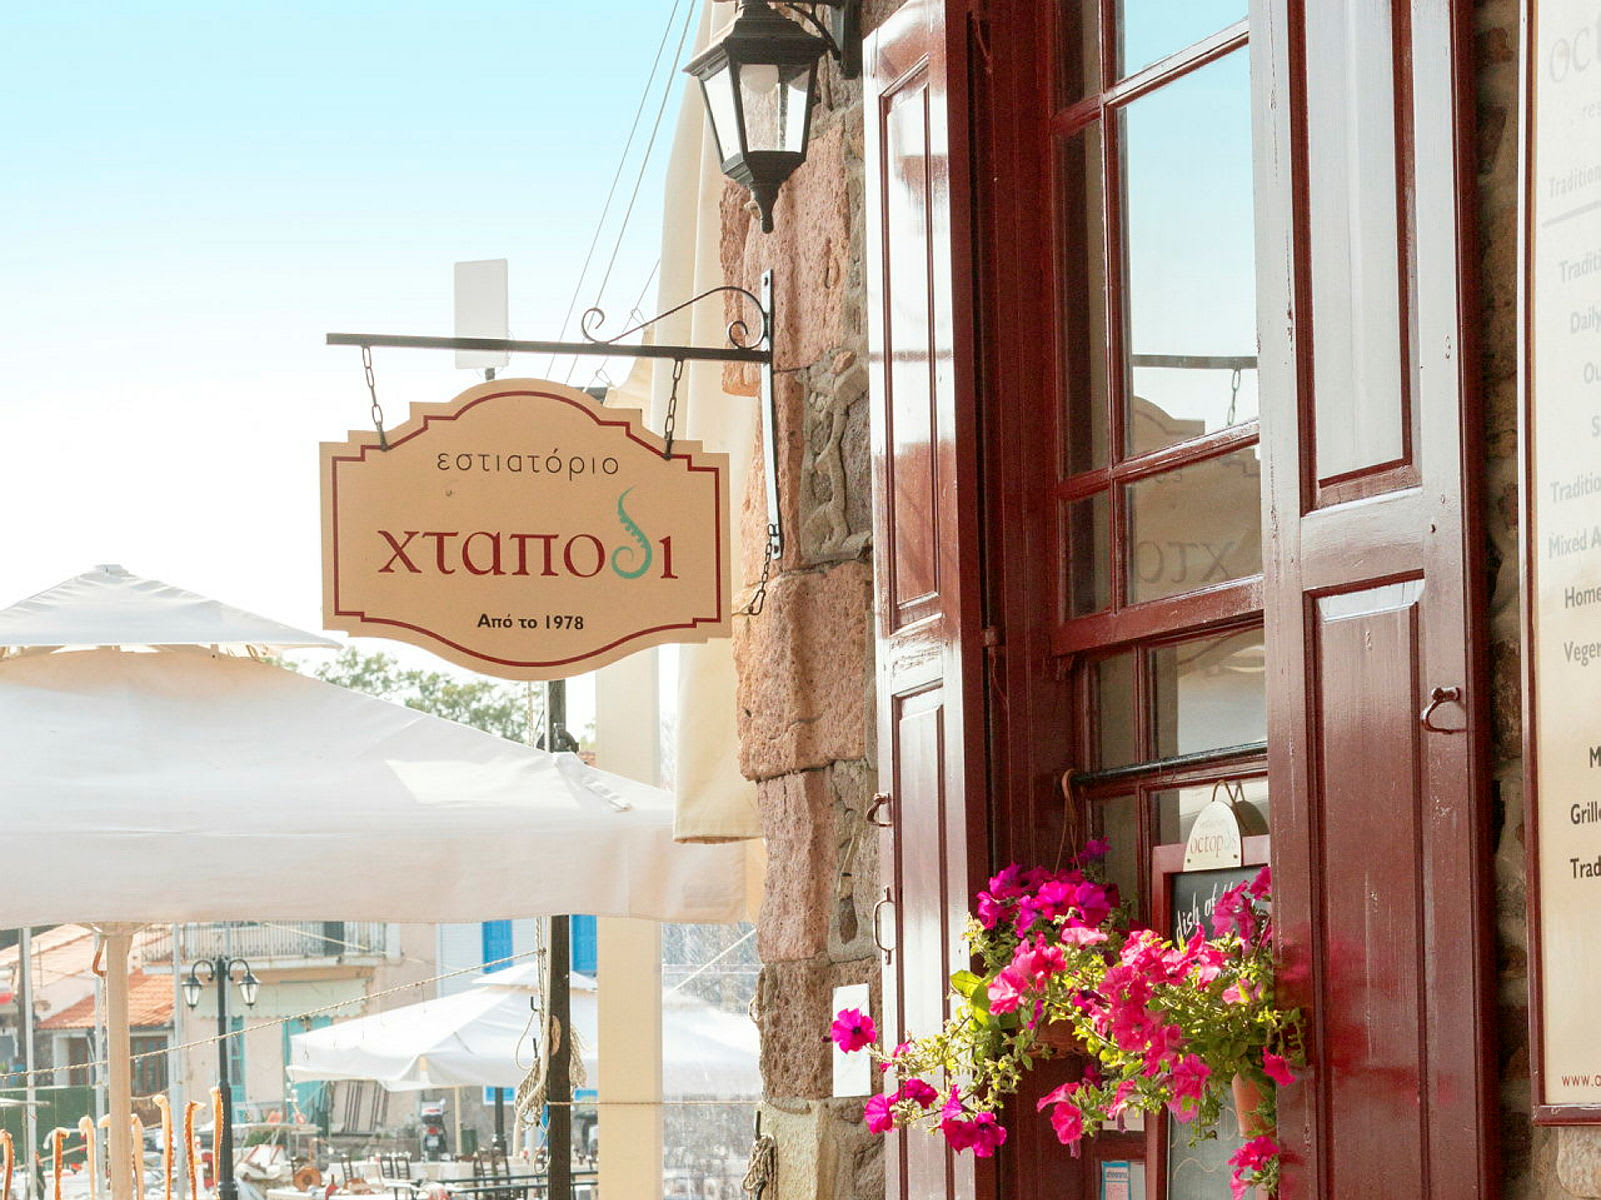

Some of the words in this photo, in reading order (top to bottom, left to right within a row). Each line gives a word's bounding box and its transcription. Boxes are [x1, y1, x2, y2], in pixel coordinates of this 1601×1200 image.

[436, 448, 619, 481] εστιατόριο
[476, 611, 514, 631] Από
[518, 617, 539, 630] το
[544, 614, 585, 631] 1978
[1570, 801, 1601, 825] Grill
